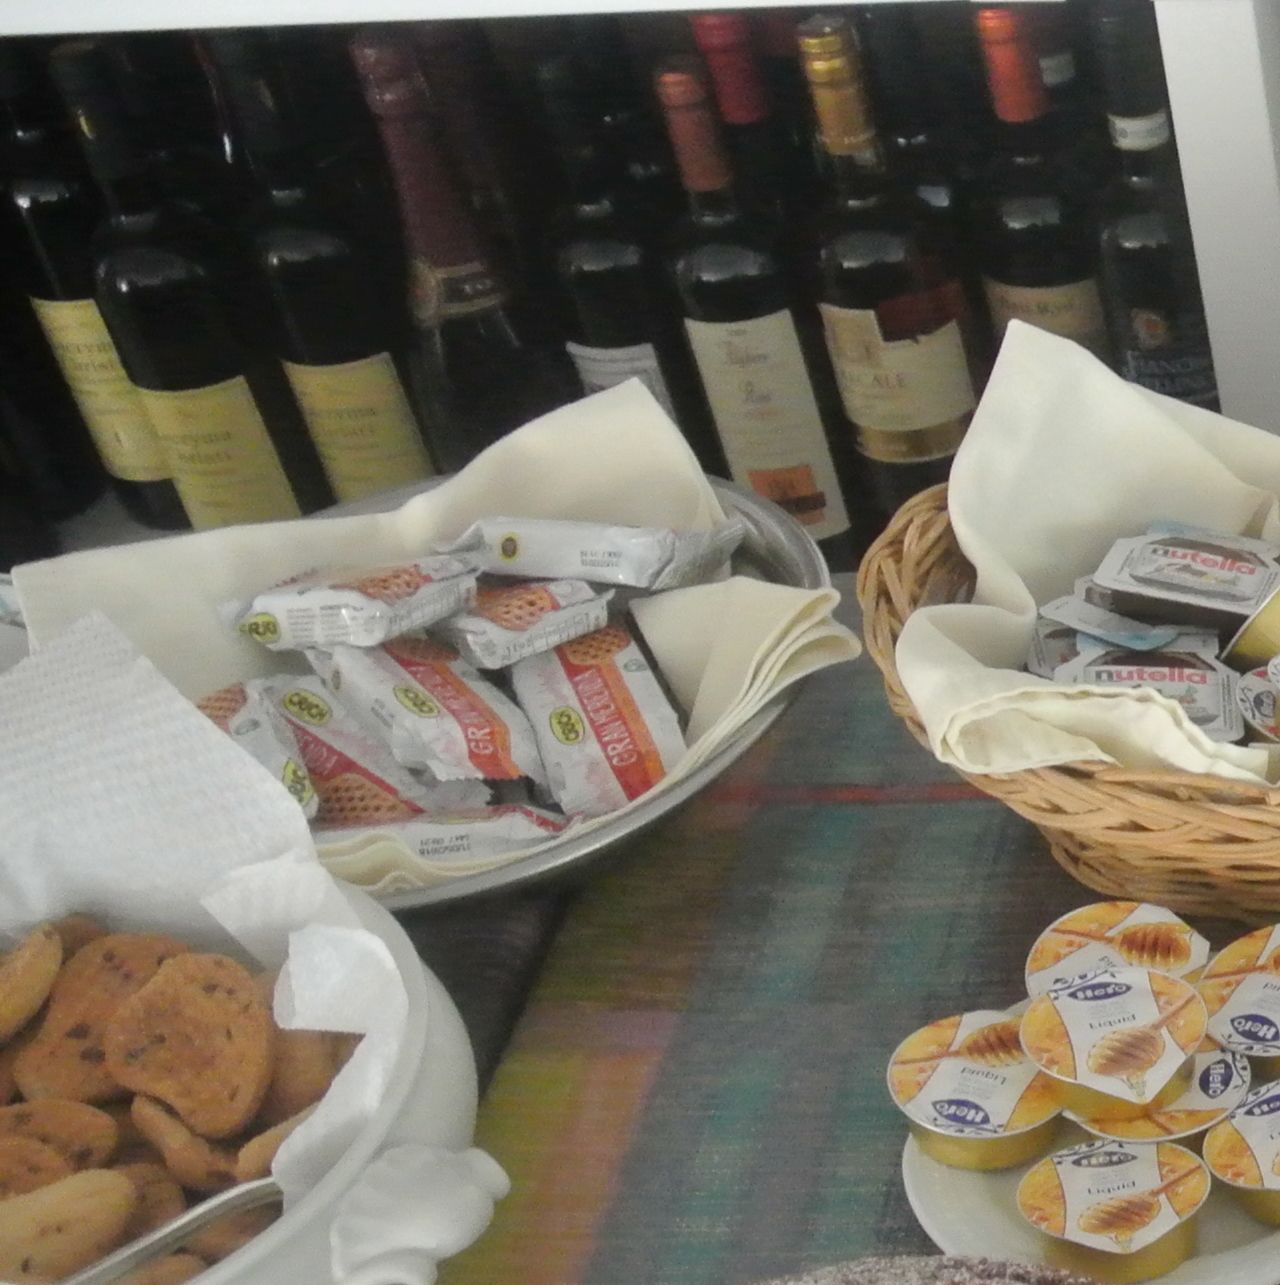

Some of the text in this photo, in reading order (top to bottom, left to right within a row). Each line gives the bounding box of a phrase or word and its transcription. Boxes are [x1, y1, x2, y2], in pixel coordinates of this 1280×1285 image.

[1151, 547, 1257, 576] nutella
[1094, 667, 1209, 685] nutella
[1074, 982, 1130, 1000] Hero
[1234, 1014, 1277, 1042] Hero
[1207, 1058, 1231, 1098] Hero
[936, 1099, 987, 1127] Hero
